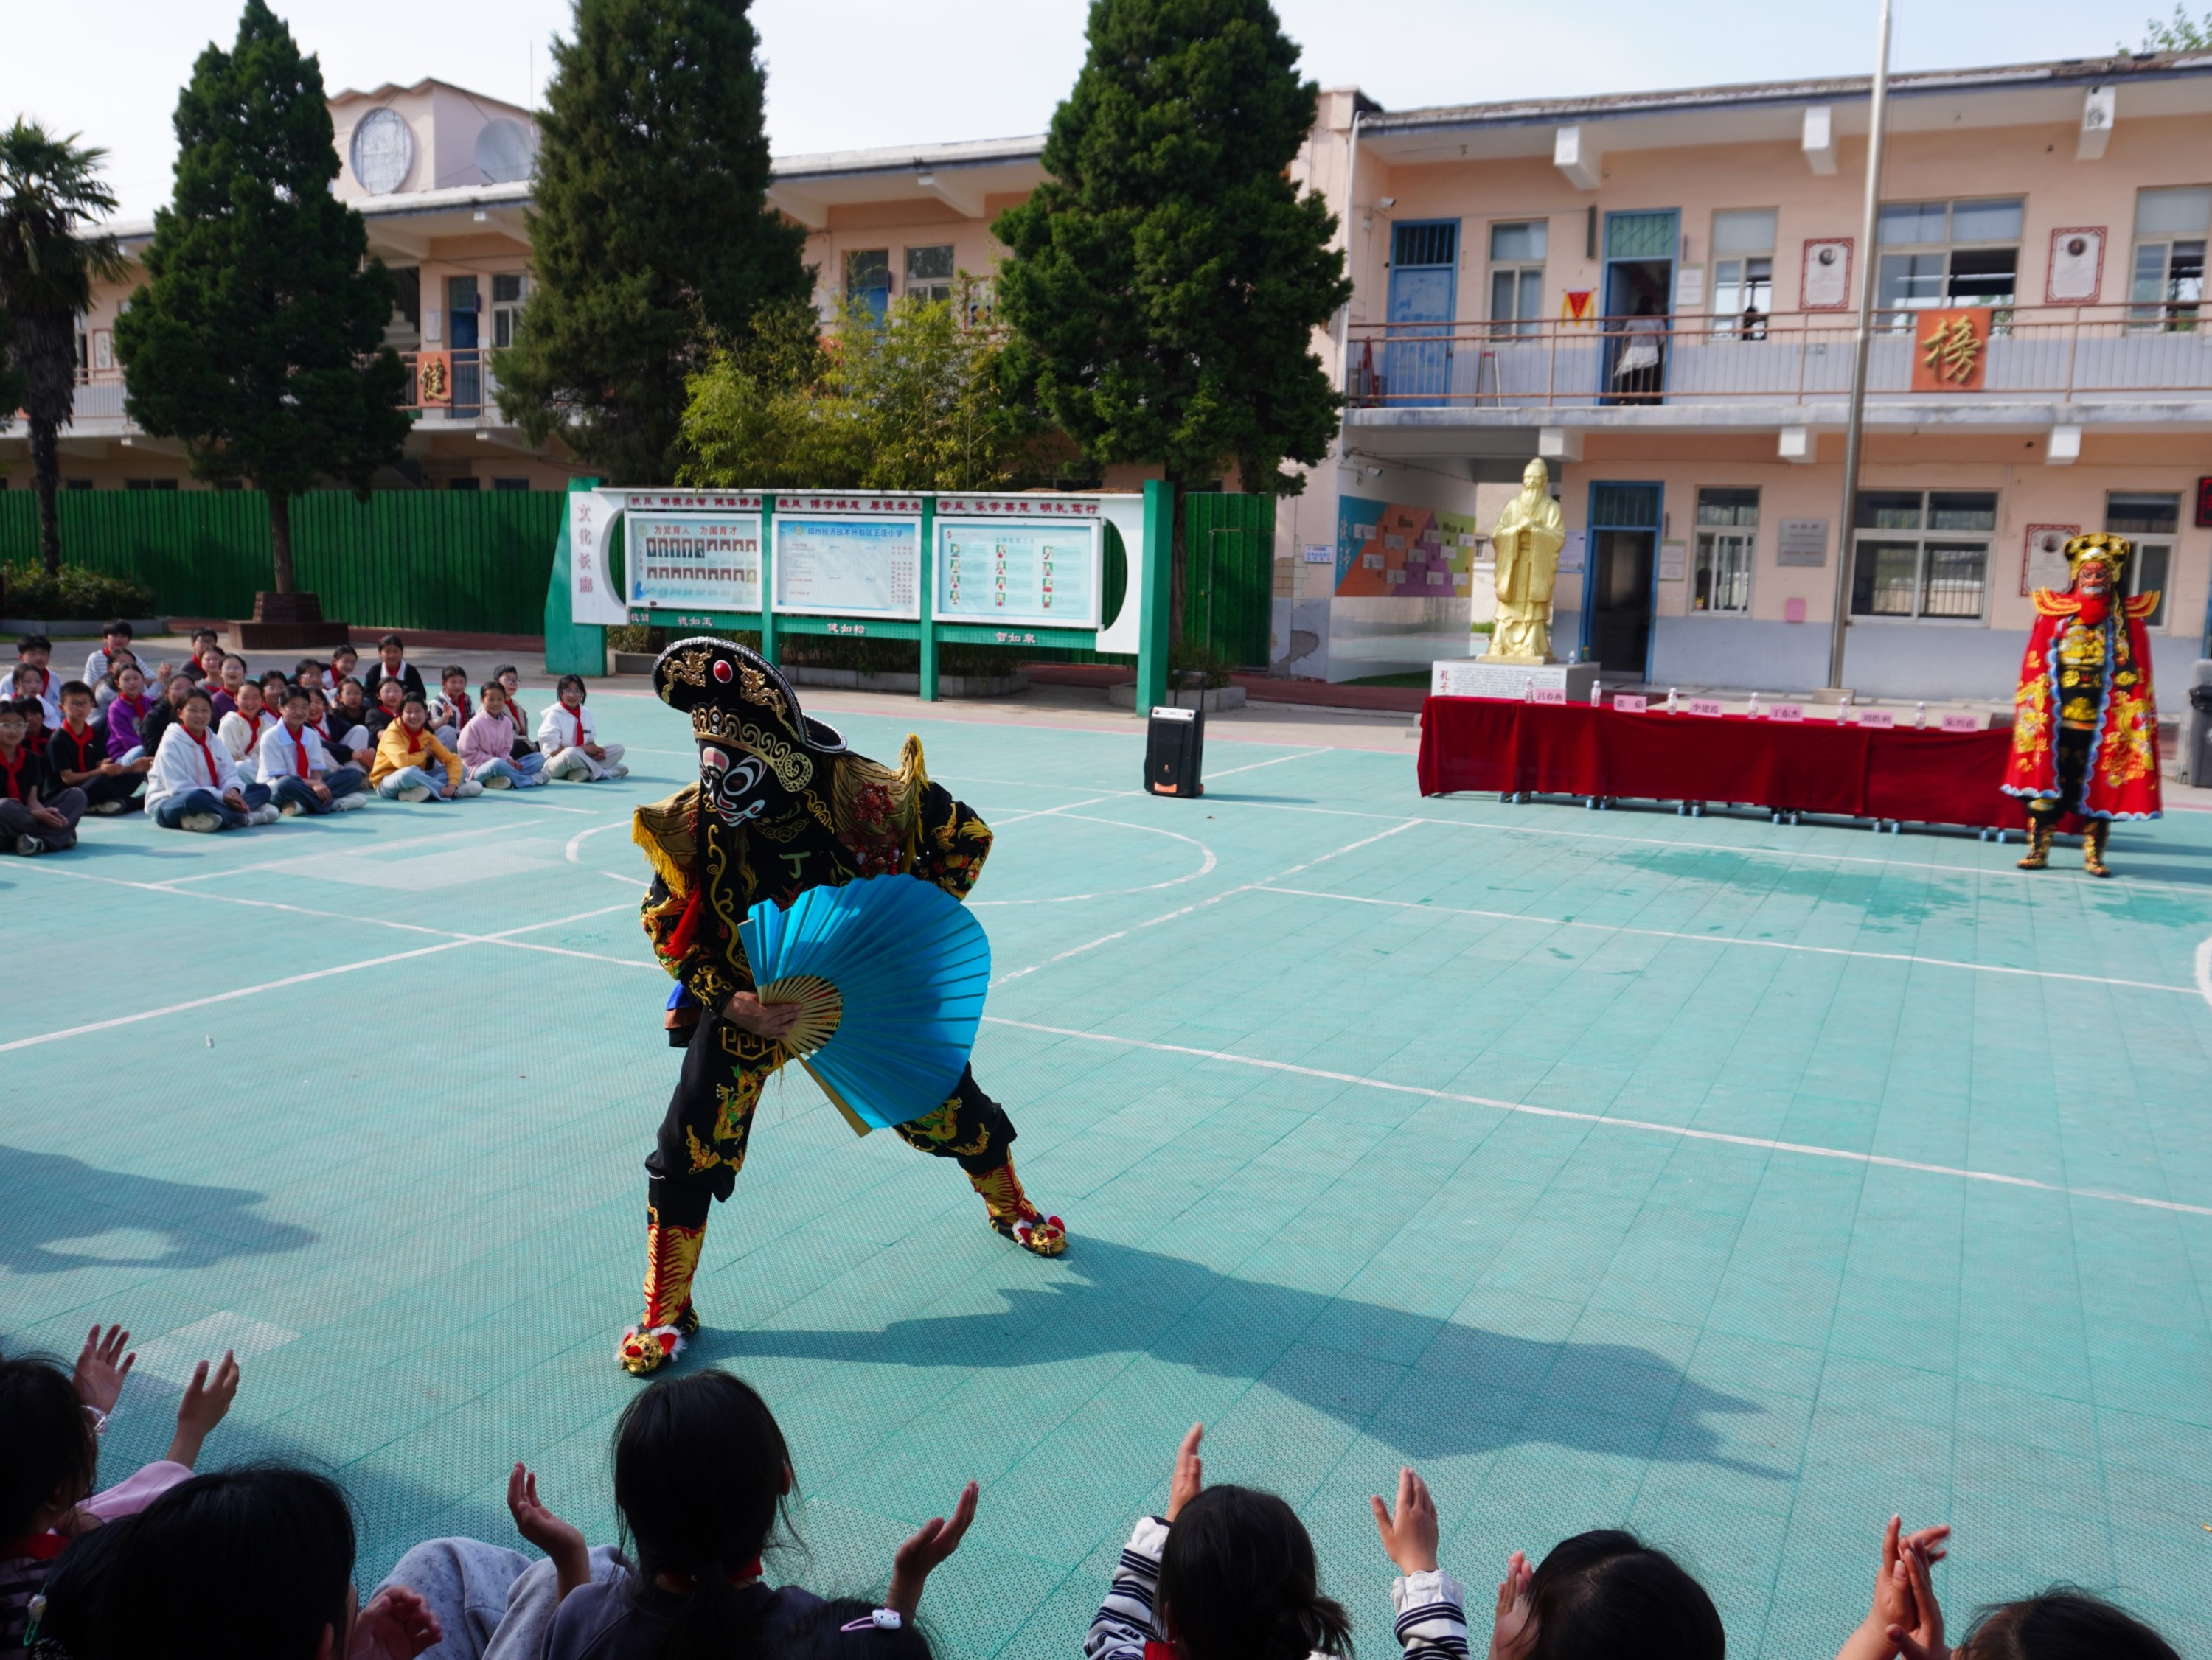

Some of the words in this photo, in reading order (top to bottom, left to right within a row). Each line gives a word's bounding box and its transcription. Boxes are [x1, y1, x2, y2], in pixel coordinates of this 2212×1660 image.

[1921, 314, 1982, 383] 榜
[810, 498, 860, 510] 博学慎思
[939, 501, 967, 511] 学风
[975, 501, 1031, 512] 乐学善思
[1040, 503, 1099, 514] 明礼笃行
[654, 526, 690, 535] 为党育人
[700, 526, 737, 536] 为国育才
[807, 527, 903, 537] 郑州经济技术开发区王庄小学
[577, 503, 593, 593] 文化长廊
[629, 613, 650, 623] 校训
[678, 616, 713, 627] 德如玉
[827, 623, 866, 634] 健如松
[995, 631, 1036, 644] 智如泉
[1439, 669, 1450, 693] 孔子
[1863, 714, 1892, 724] 刘胜利
